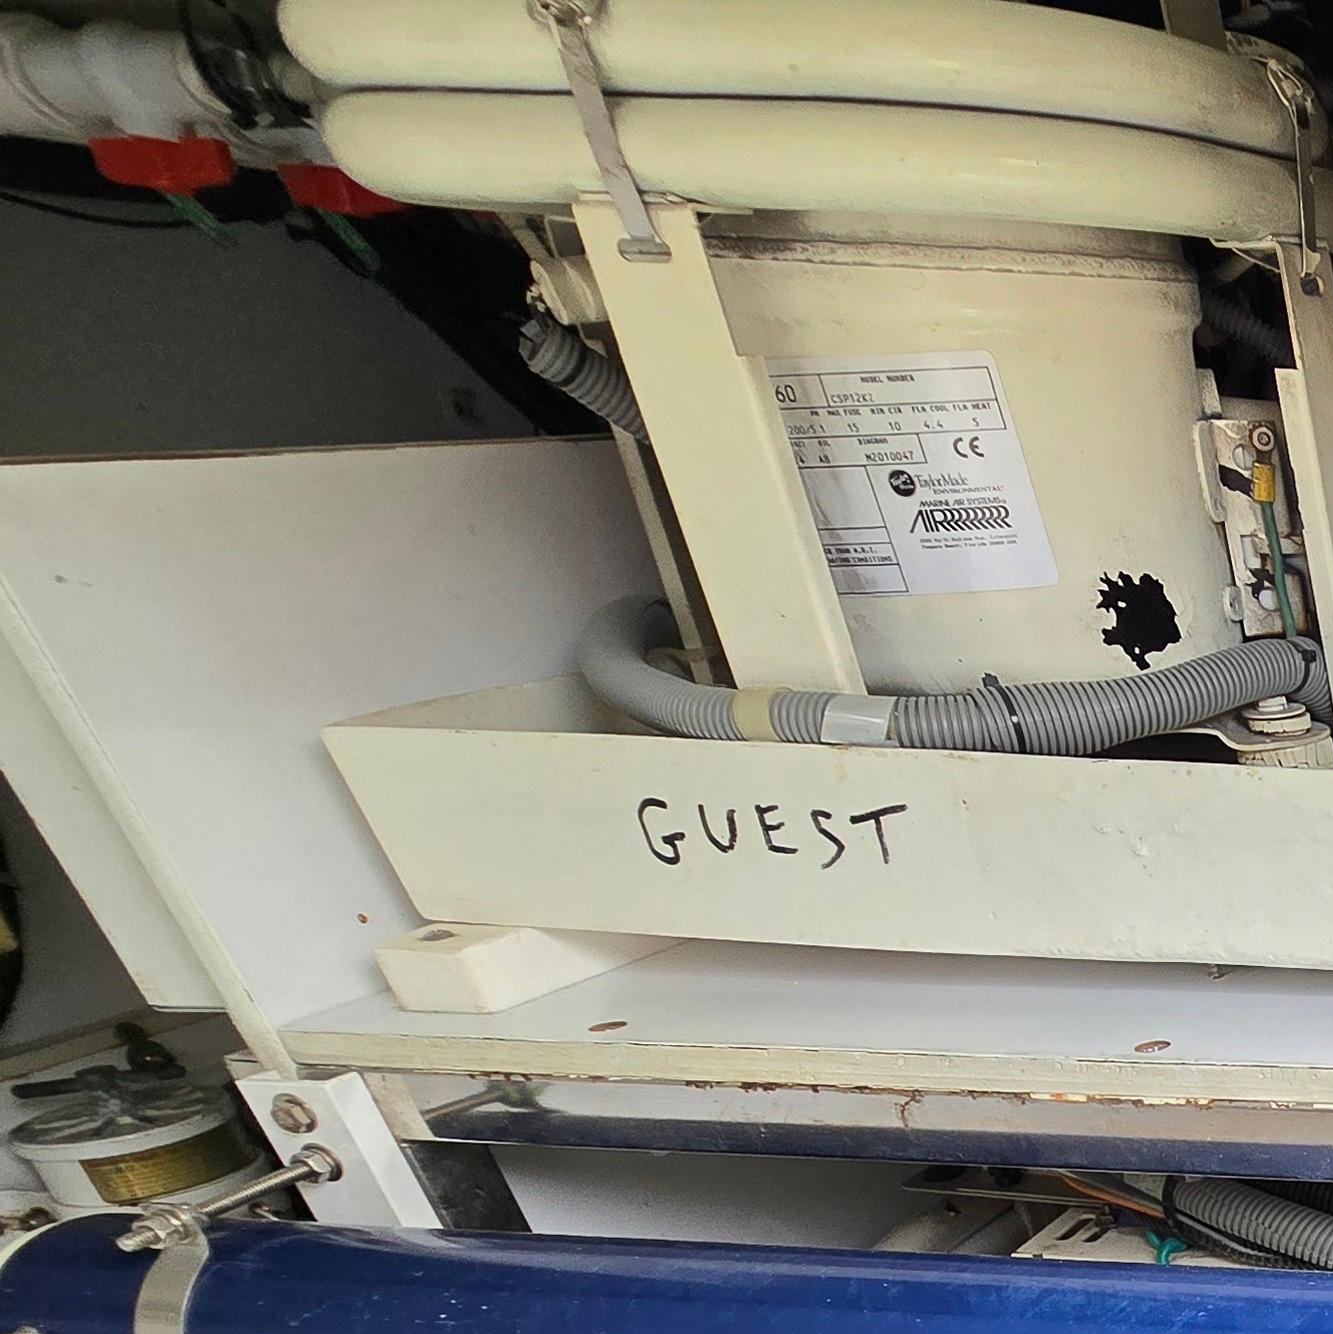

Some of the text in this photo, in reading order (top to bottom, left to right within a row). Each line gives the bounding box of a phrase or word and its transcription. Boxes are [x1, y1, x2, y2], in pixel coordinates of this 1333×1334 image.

[888, 421, 902, 432] 10
[952, 436, 985, 459] CE
[638, 797, 908, 869] GUEST
